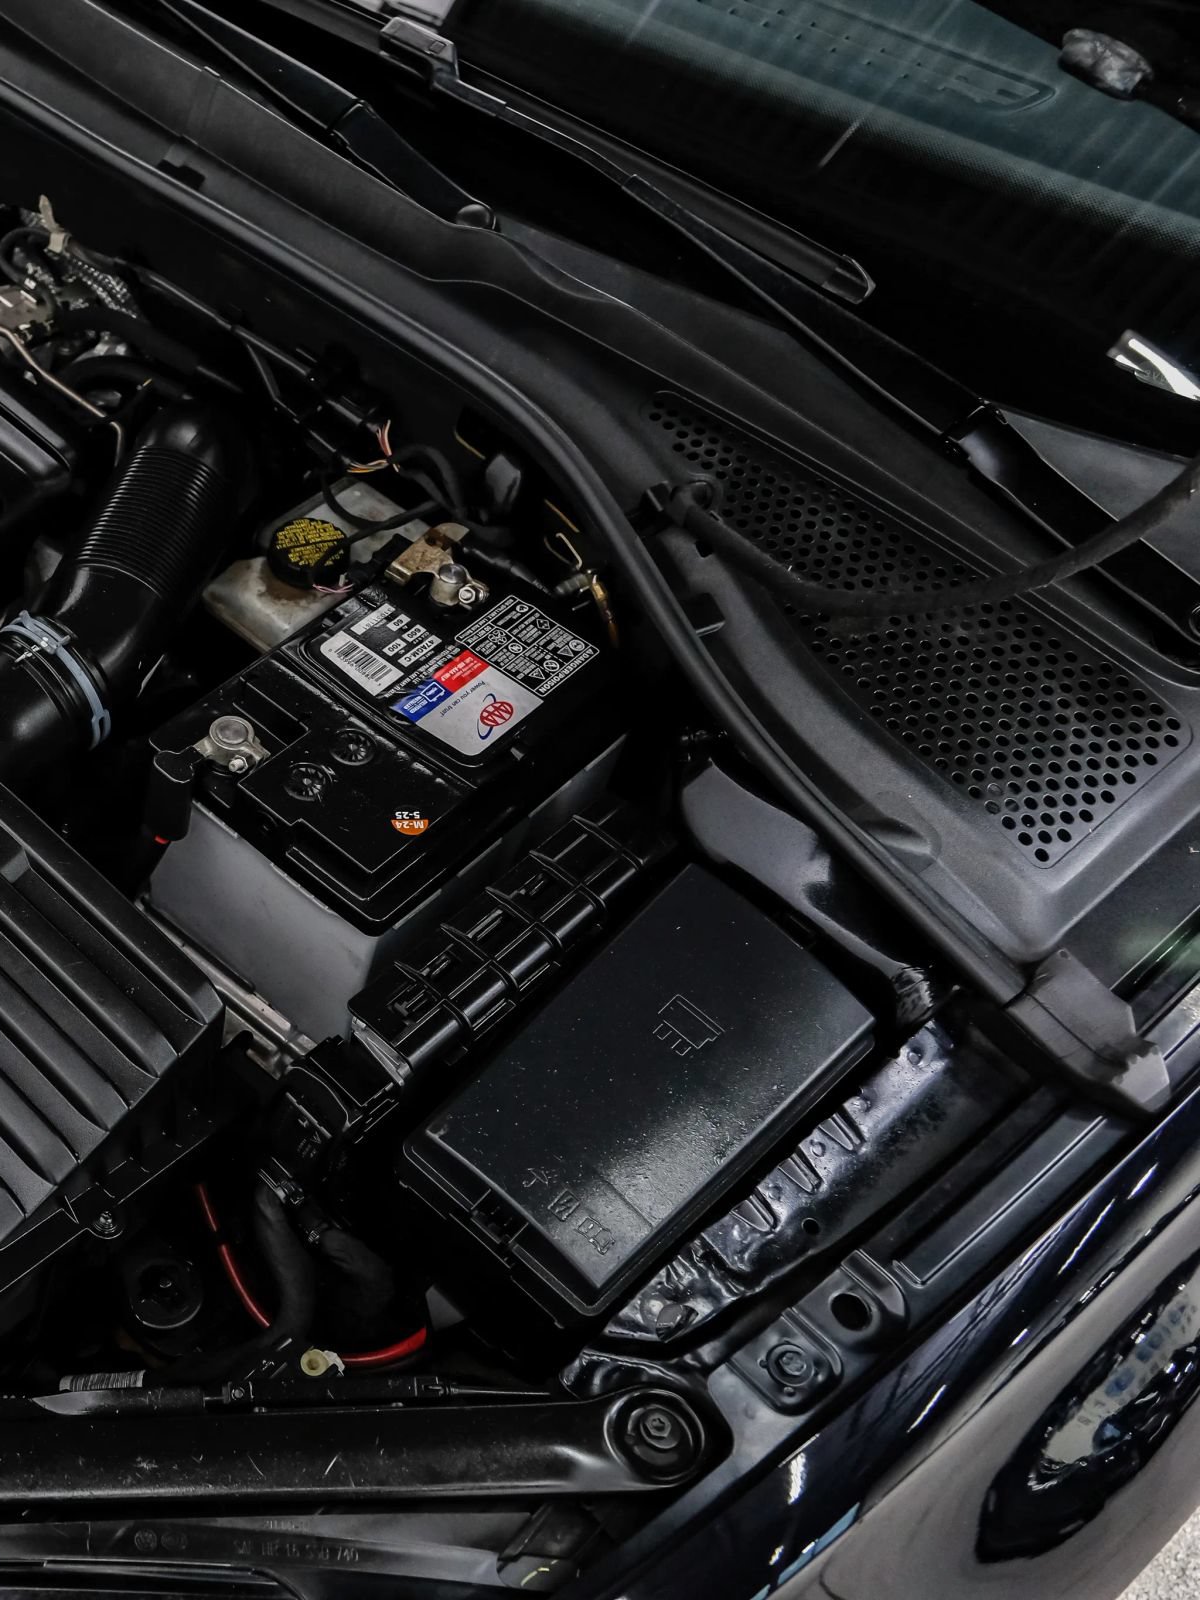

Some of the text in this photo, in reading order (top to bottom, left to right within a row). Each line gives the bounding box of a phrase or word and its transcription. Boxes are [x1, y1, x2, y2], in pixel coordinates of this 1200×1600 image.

[407, 628, 421, 638] 600
[388, 643, 401, 652] 100
[404, 638, 434, 662] 47AGM-C
[539, 653, 589, 693] DANGER/POISON
[470, 681, 486, 693] Power
[460, 690, 470, 700] you
[451, 698, 461, 706] can
[481, 702, 512, 726] AAA
[395, 821, 424, 829] M-24
